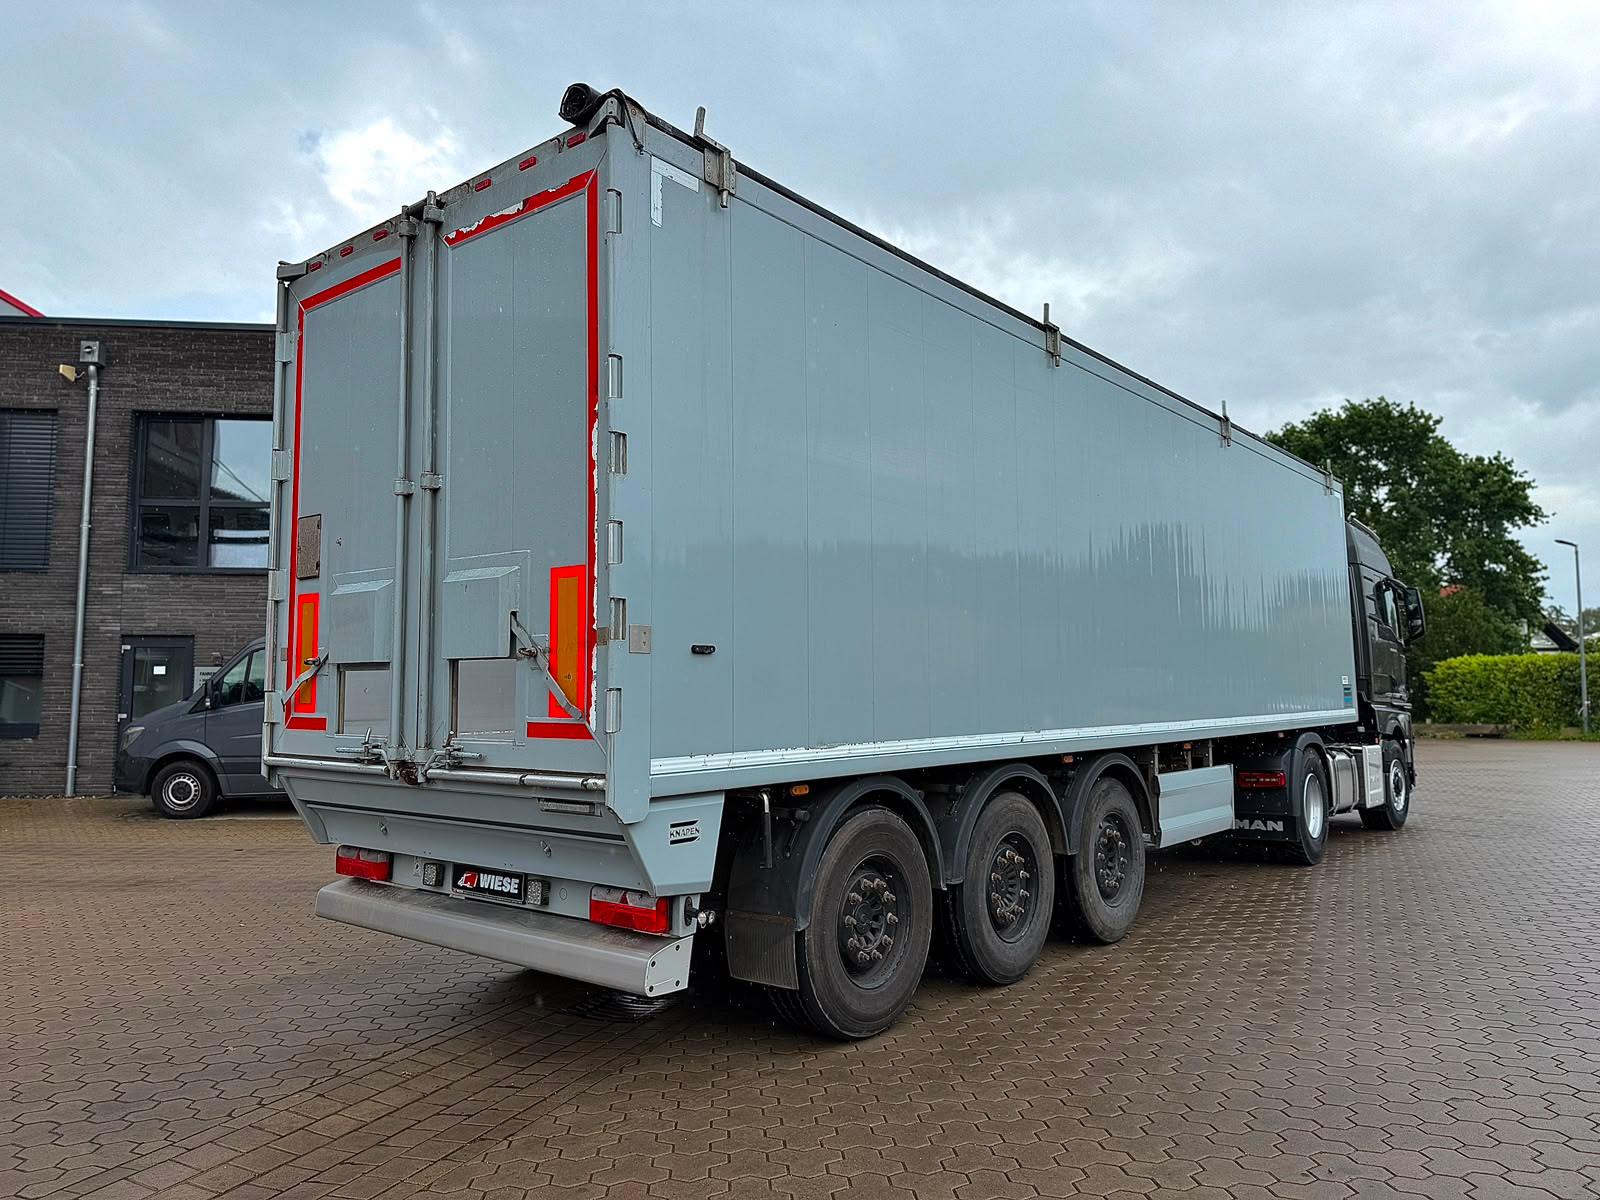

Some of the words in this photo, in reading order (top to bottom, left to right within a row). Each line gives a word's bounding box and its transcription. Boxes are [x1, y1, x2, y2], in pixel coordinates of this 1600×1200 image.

[1235, 819, 1284, 832] MAN
[670, 827, 700, 838] KNAPEN
[480, 873, 519, 894] WIESE
